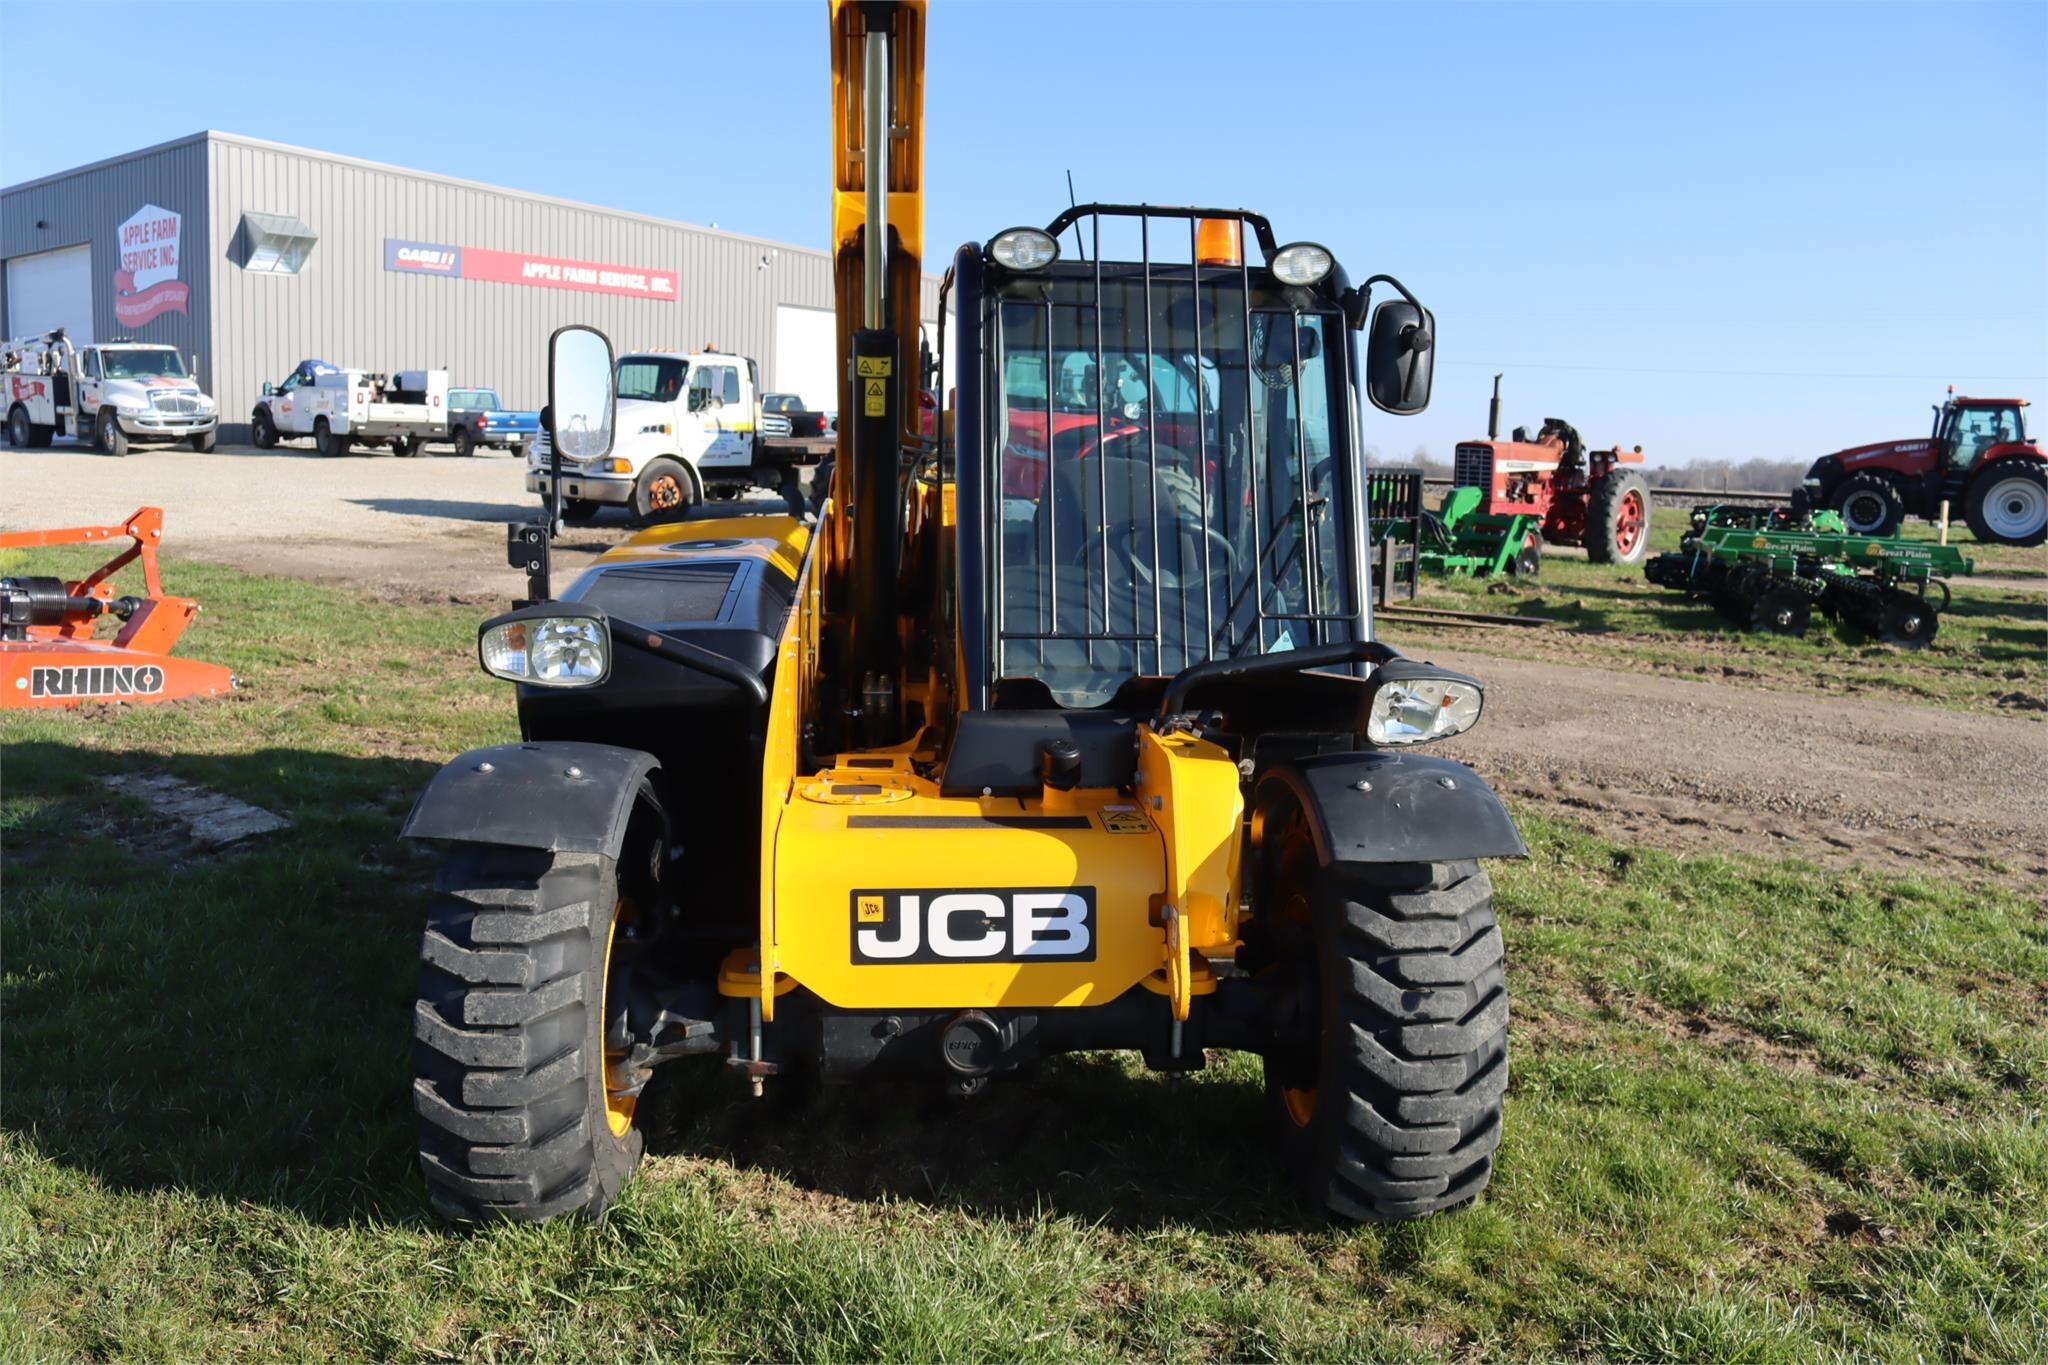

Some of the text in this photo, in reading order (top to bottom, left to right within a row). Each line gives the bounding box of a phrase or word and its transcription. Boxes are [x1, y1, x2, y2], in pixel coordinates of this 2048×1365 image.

[123, 217, 177, 247] APPLE FARM
[122, 245, 178, 272] SERVICE INC.
[398, 247, 440, 263] CASE
[522, 262, 673, 293] APPLE FARM SERVICE, INC.
[1894, 443, 1919, 452] CASE
[1765, 542, 1788, 551] Great
[1791, 543, 1817, 553] Plains
[1879, 548, 1903, 557] Great
[1905, 550, 1932, 559] Plains
[32, 666, 163, 698] RHINO
[864, 902, 880, 915] JCB
[857, 893, 1090, 959] JCB
